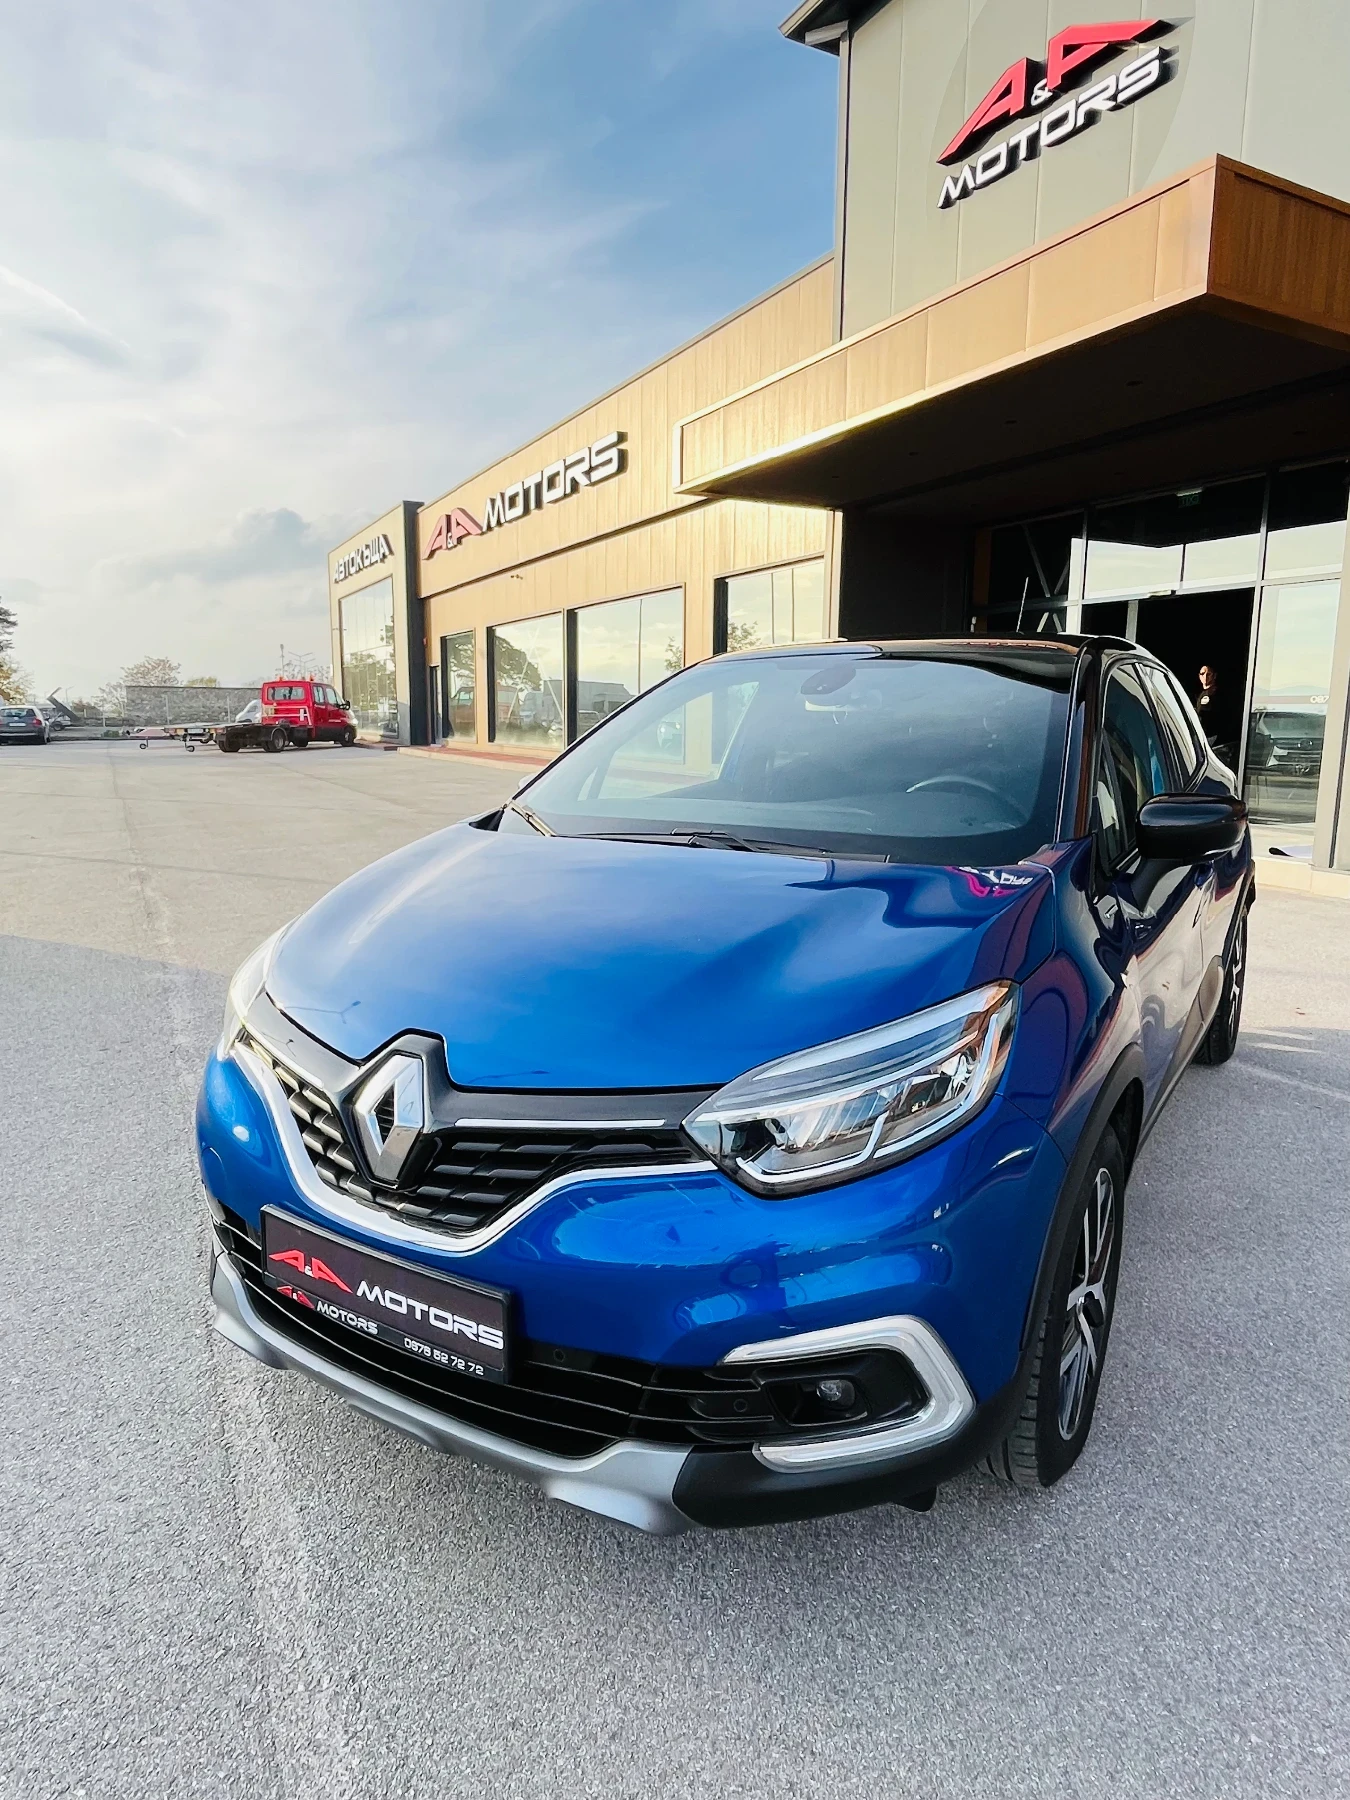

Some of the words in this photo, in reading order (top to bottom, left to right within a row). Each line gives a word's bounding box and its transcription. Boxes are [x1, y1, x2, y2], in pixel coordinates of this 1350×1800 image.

[937, 46, 1161, 208] MOTORS
[482, 431, 626, 532] MOTORS
[333, 534, 391, 583] АВТОКЪЩА
[317, 1300, 378, 1335] MOTORS
[356, 1280, 504, 1350] MOTORS
[450, 1355, 466, 1371] 72
[467, 1362, 484, 1376] 72
